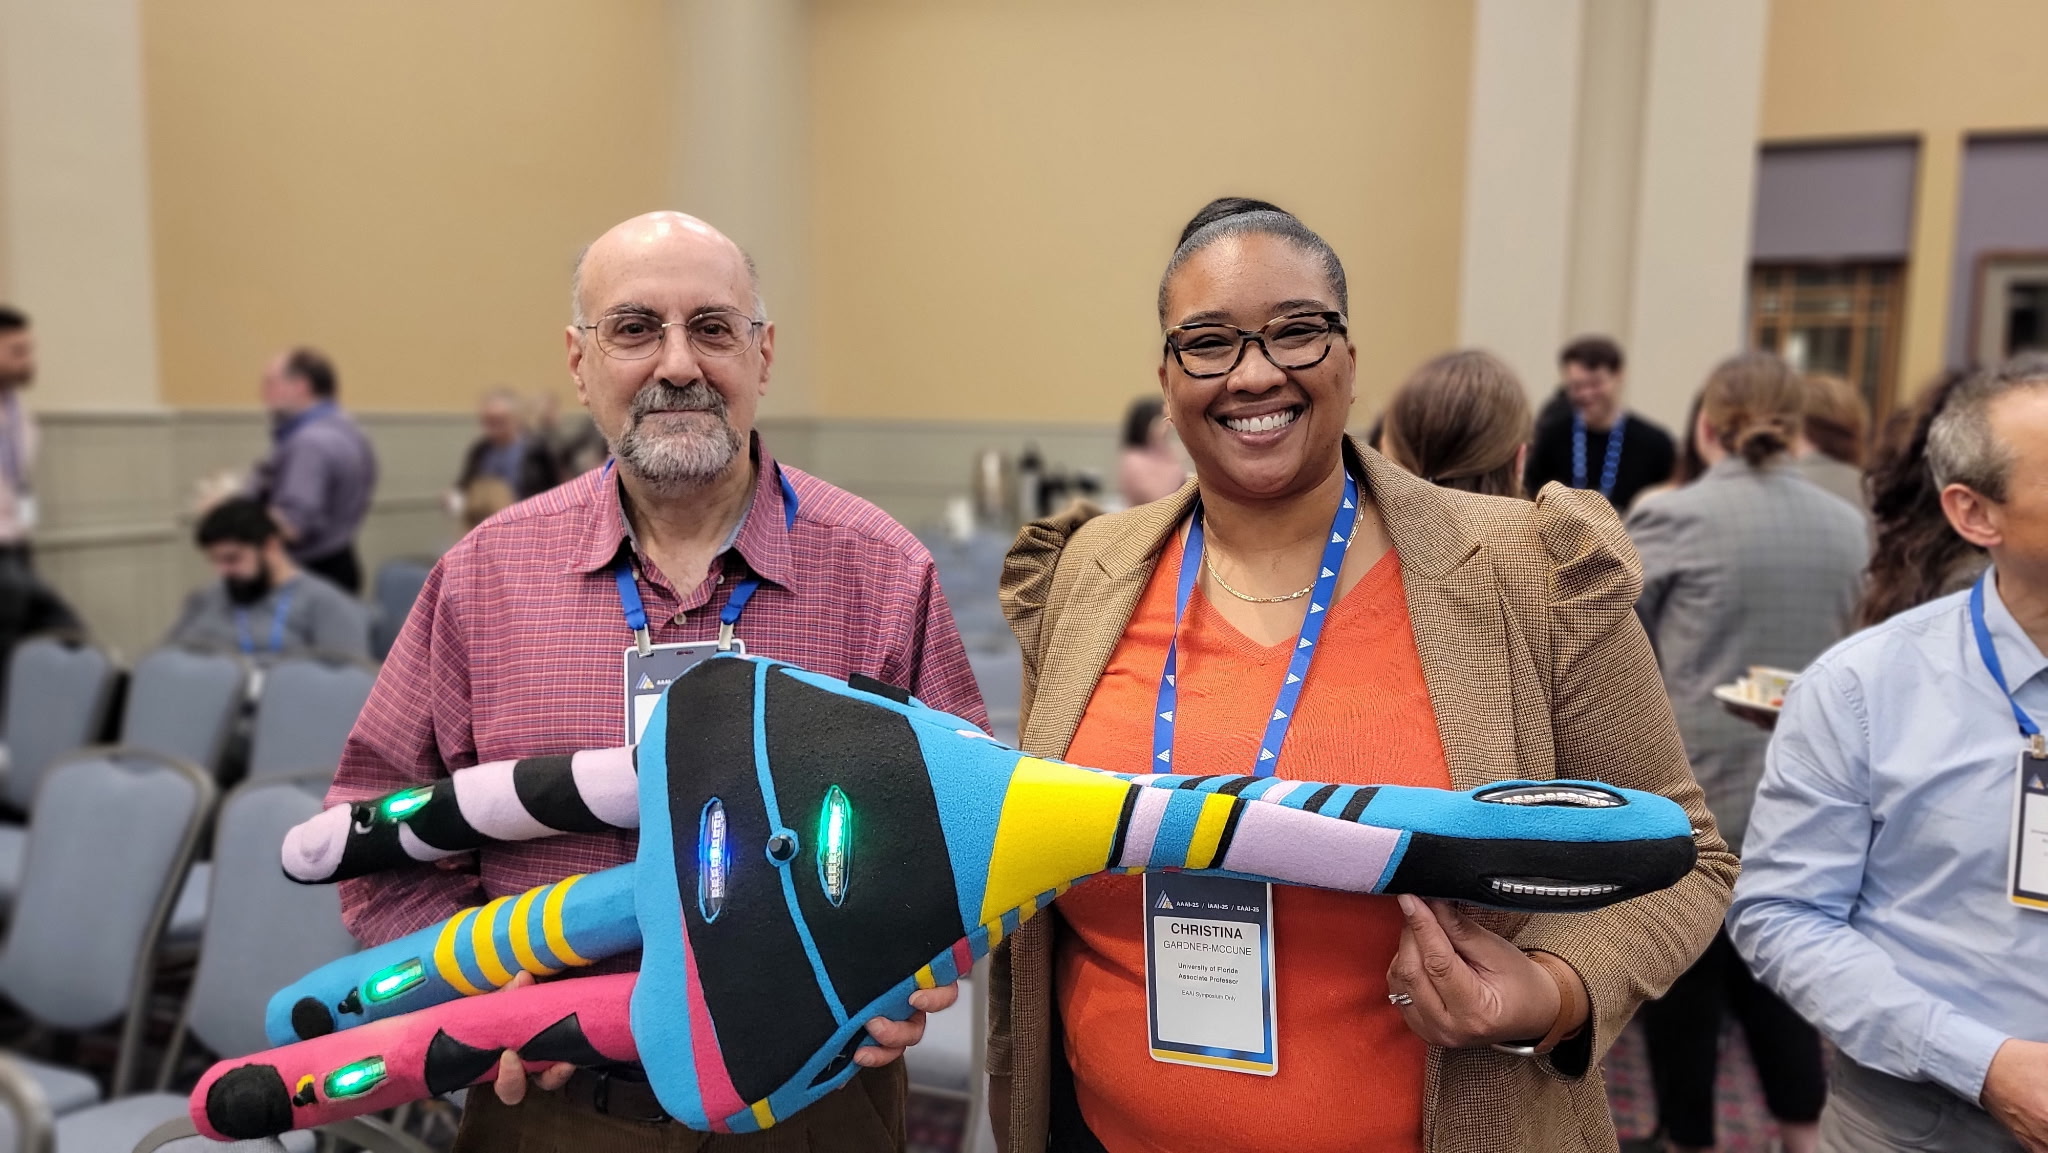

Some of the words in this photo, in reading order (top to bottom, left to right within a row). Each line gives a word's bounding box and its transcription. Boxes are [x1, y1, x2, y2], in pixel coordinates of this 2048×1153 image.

[1207, 902, 1229, 910] IAAI-25
[1236, 905, 1260, 913] EAAI-25
[1170, 922, 1243, 940] CHRISTINA
[1163, 940, 1252, 956] GARDNER-MCCUNE
[1178, 962, 1208, 973] University
[1217, 966, 1239, 974] Florida
[1178, 973, 1208, 982] Associate
[1209, 975, 1239, 985] Professor
